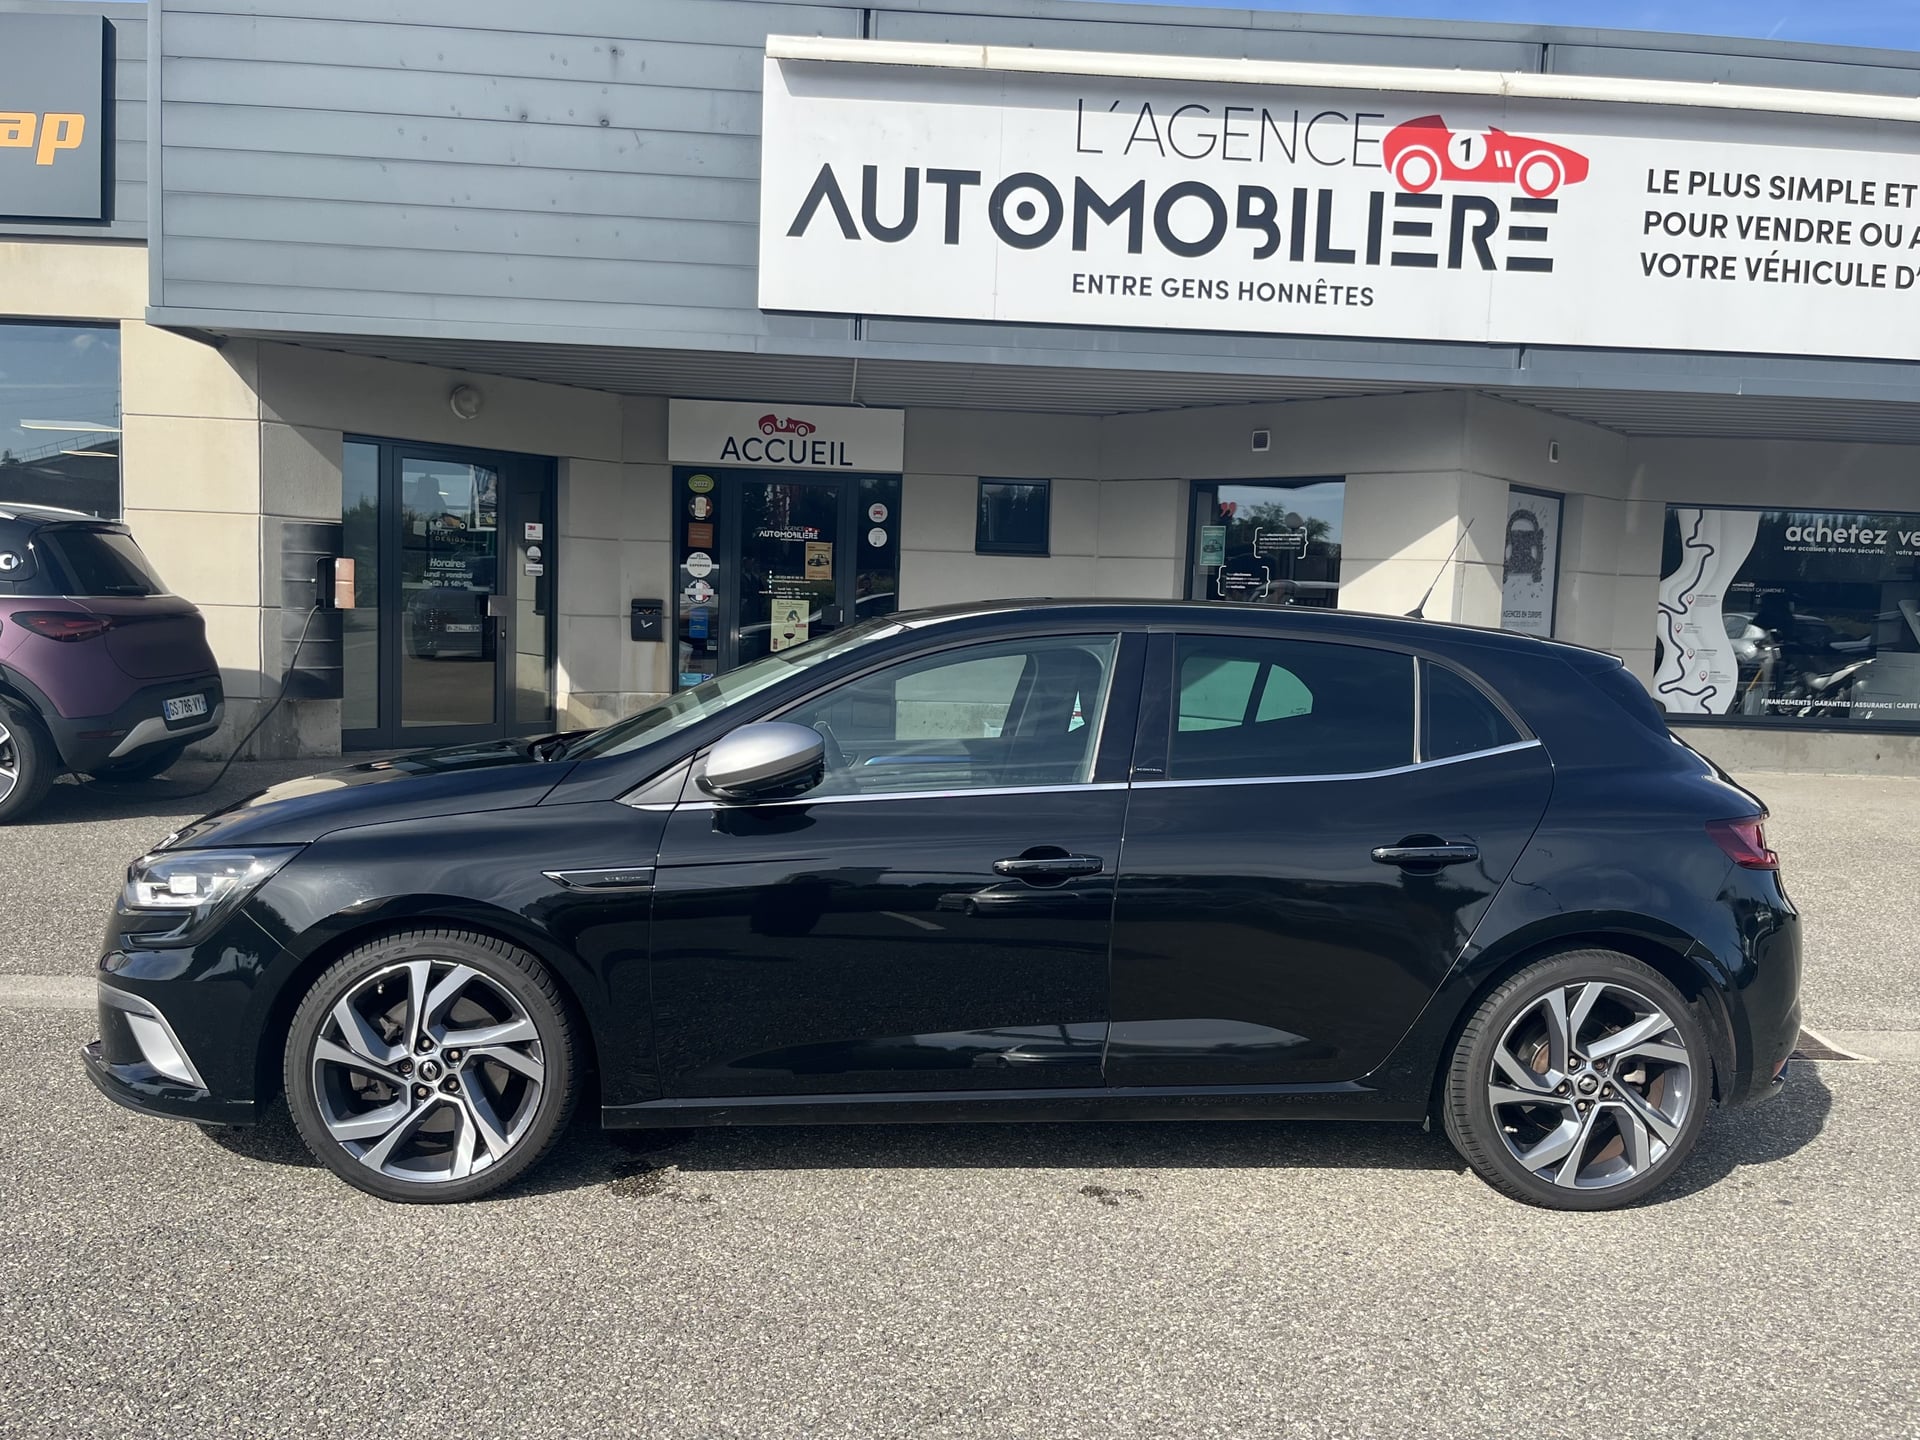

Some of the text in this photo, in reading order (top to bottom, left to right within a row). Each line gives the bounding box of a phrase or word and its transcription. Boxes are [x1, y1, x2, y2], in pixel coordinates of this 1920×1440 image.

[1076, 98, 1385, 168] L'AGENCE
[1459, 137, 1473, 162] 1
[1646, 168, 1918, 209] LE PLUS SIMPLE ET
[1643, 210, 1727, 240] POUR
[1736, 215, 1852, 246] VENDRE
[1859, 222, 1903, 248] OU
[1640, 251, 1736, 281] VOTRE
[1745, 250, 1887, 289] VÉHICULE
[1072, 273, 1375, 307] ENTRE GENS HONNÊTES
[720, 436, 853, 467] ACCUEIL
[1785, 518, 1888, 545] achetez
[430, 558, 467, 568] Horaires
[1761, 698, 1811, 707] FINANCEMENTS
[1814, 700, 1850, 708] GARANTIES
